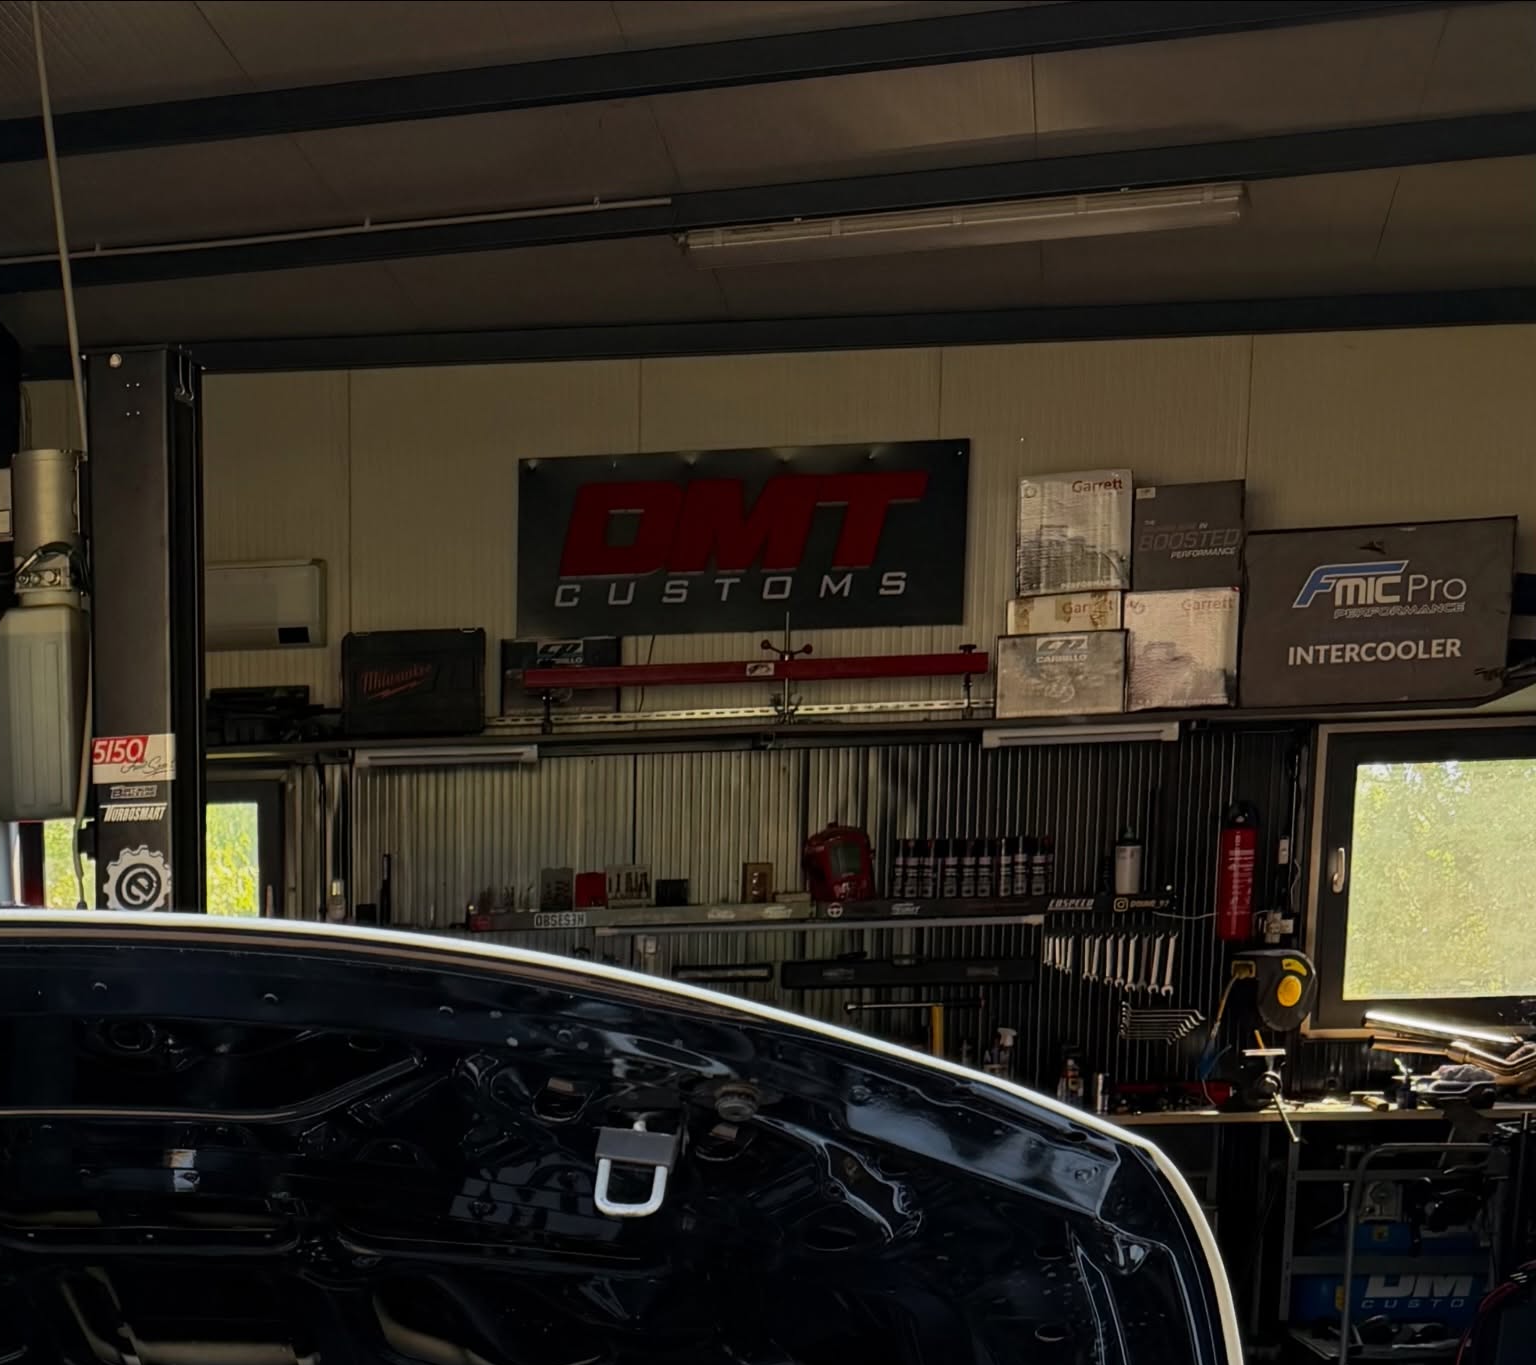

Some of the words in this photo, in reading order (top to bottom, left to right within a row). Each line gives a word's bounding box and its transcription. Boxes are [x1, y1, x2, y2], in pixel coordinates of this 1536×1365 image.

[1071, 479, 1124, 494] Garrett
[559, 469, 931, 579] DMT
[1138, 529, 1241, 551] BOOSTED
[1170, 547, 1236, 559] PERFORMANCE
[554, 571, 908, 608] CUSTOMS
[1407, 573, 1468, 603] Pro
[1181, 599, 1233, 612] Garrett
[1333, 601, 1466, 619] PERFORMANCE
[1287, 638, 1462, 667] INTERCOOLER
[93, 738, 144, 764] 5150
[99, 803, 168, 823] TURBOSMART
[1364, 1274, 1473, 1298] DM
[1360, 1298, 1465, 1310] CUSTO
